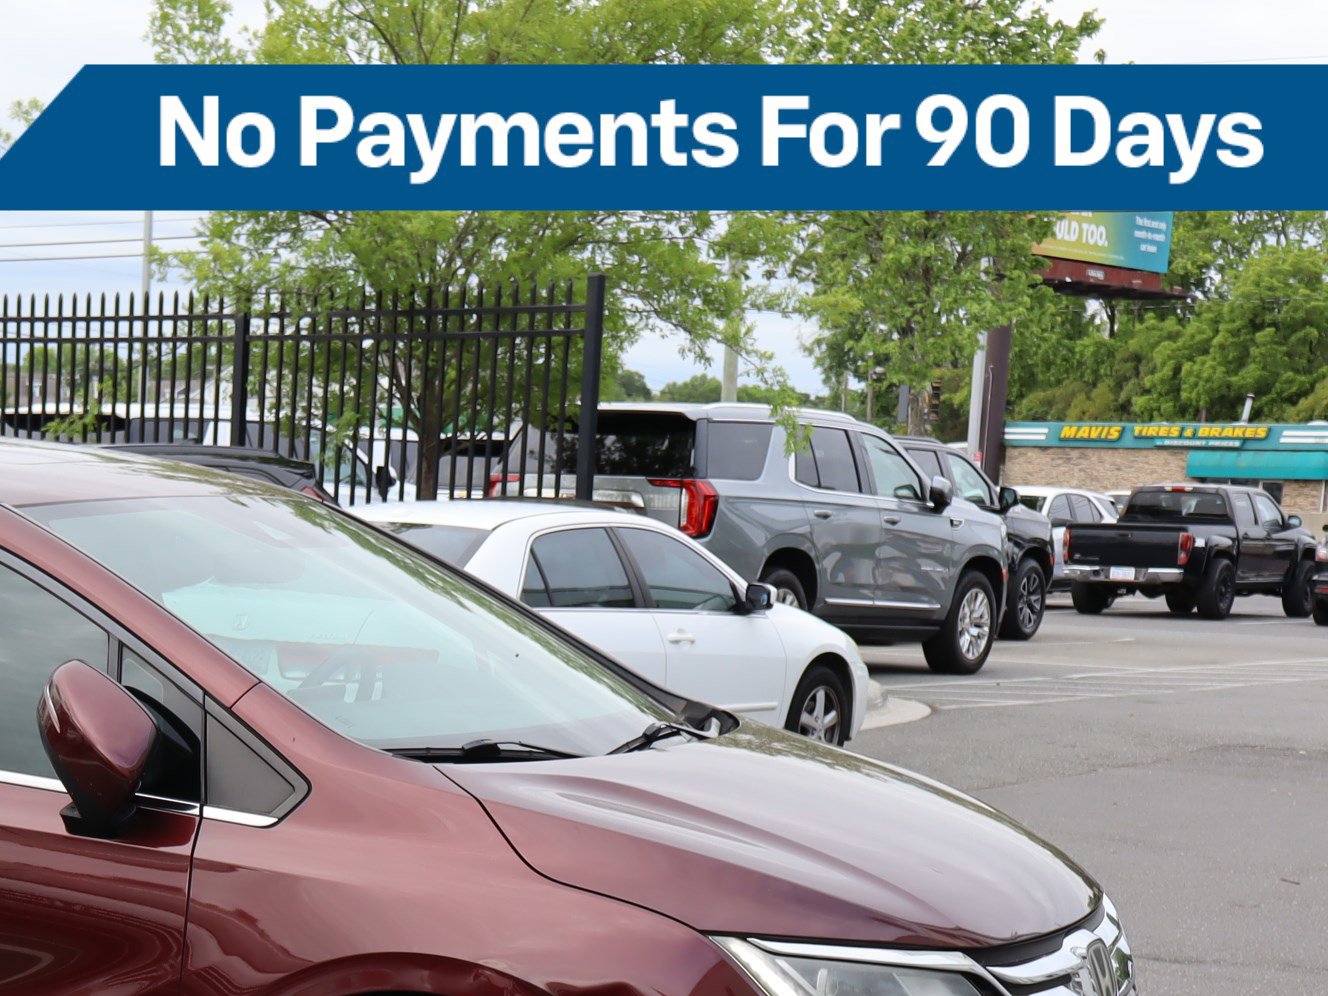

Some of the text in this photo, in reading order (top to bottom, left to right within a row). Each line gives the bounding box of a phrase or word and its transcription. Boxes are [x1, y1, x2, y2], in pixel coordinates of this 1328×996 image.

[1082, 222, 1109, 248] TOO.
[1060, 425, 1268, 440] MAVIS TIRES & BRAKES
